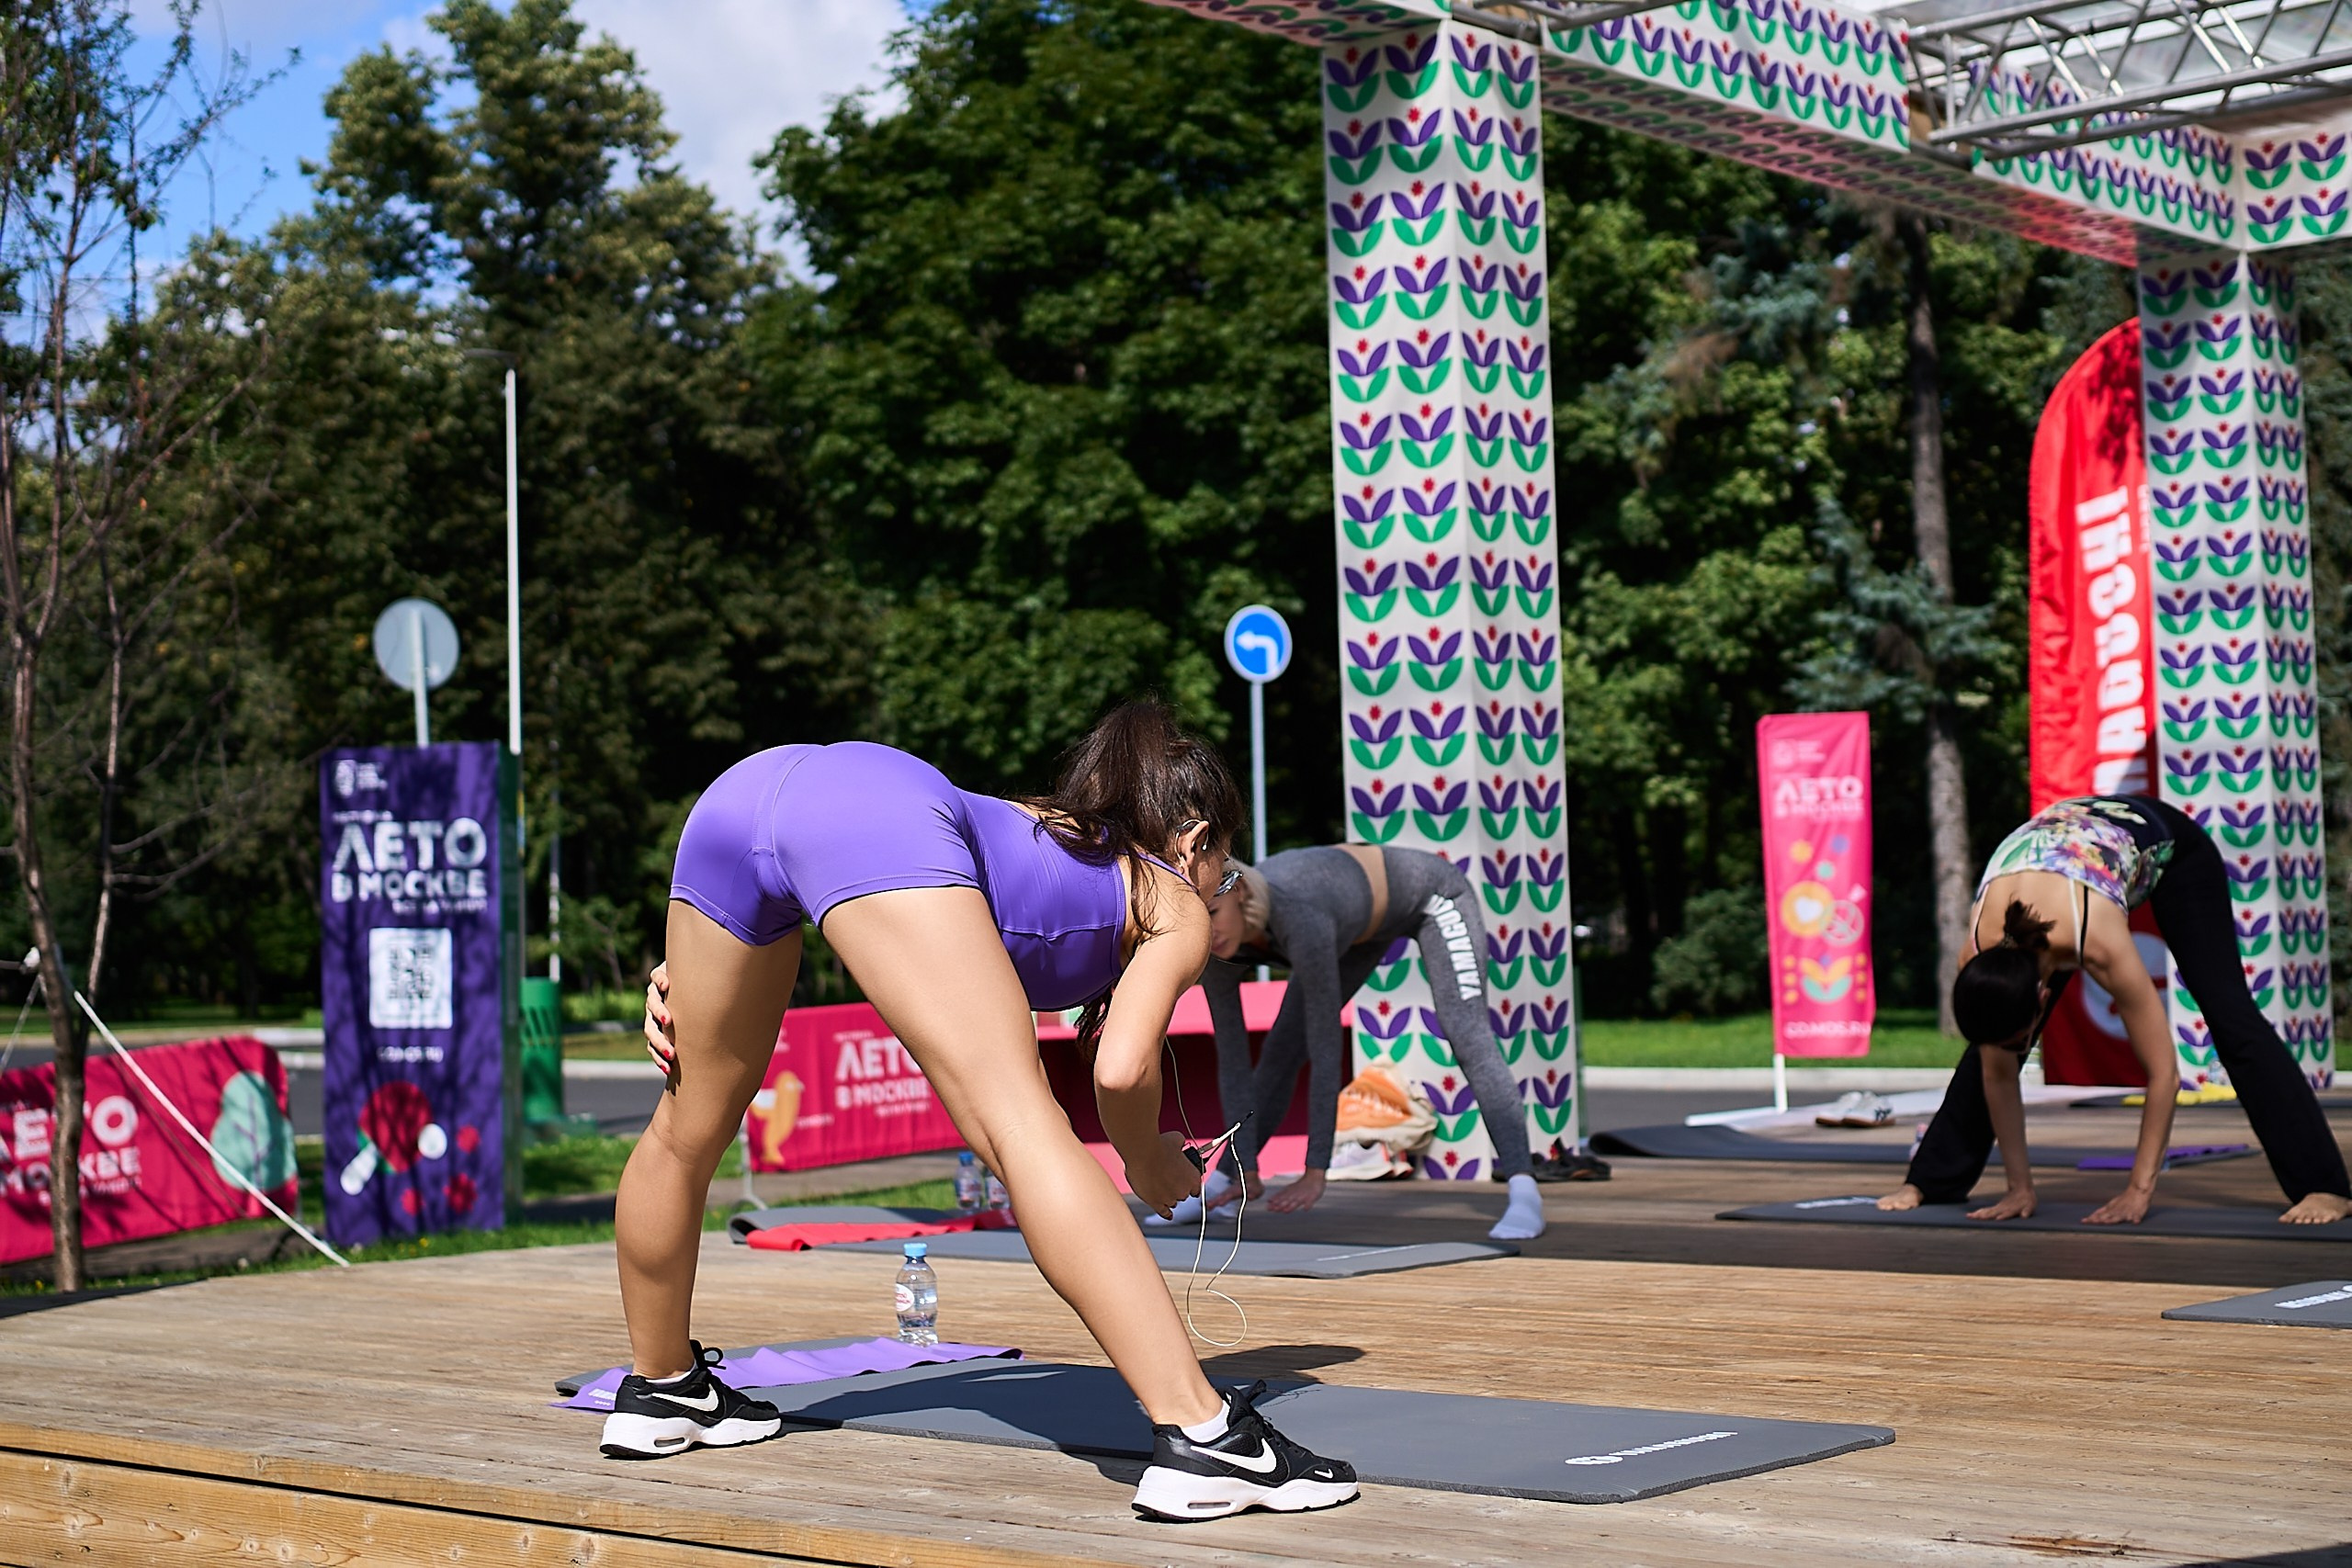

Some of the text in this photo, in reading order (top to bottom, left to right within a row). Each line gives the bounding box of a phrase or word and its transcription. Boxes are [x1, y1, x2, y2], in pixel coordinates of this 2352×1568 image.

[332, 817, 488, 874] ЛЕТО
[332, 868, 488, 903] В МОСКВЕ
